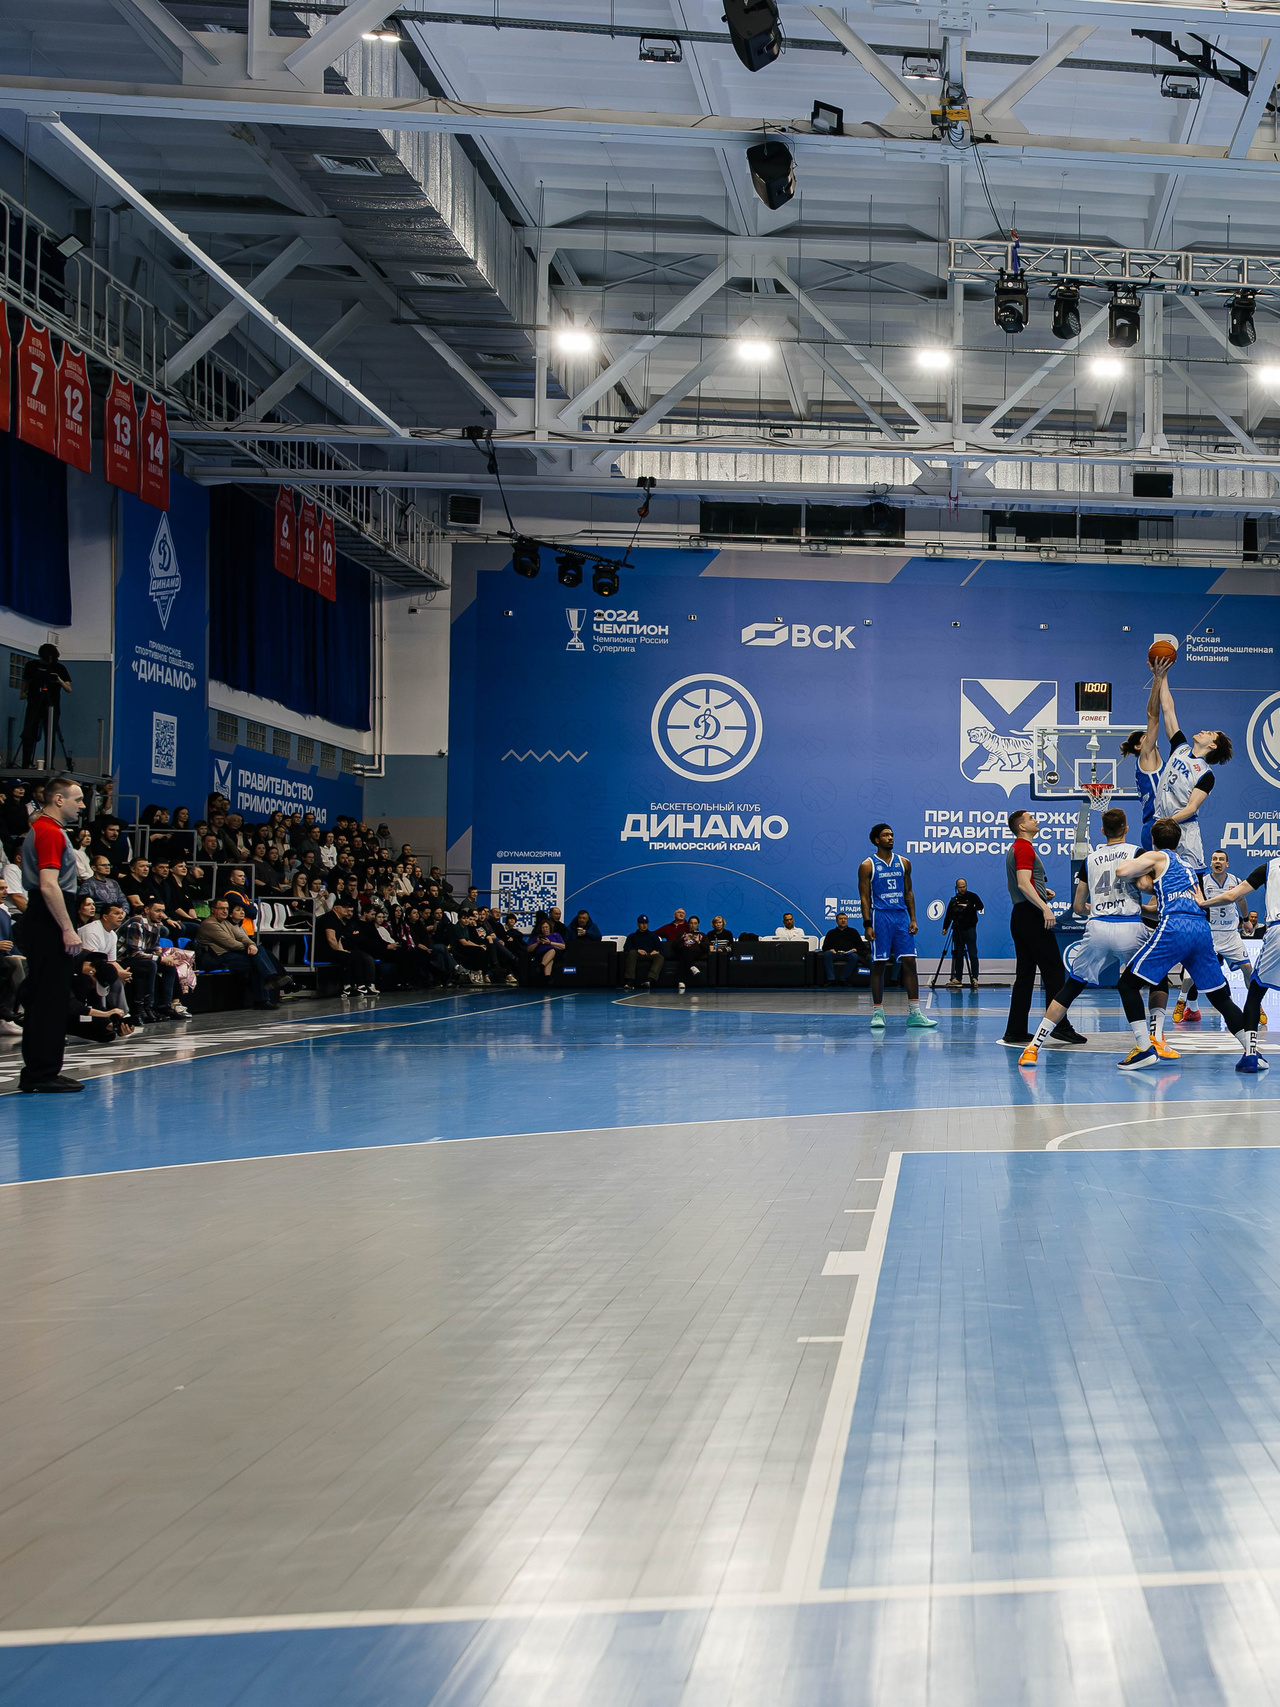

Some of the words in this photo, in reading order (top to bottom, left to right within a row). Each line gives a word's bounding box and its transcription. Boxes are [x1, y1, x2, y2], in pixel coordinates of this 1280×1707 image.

[31, 362, 44, 396] 7
[64, 385, 83, 422] 12
[113, 412, 131, 446] 13
[148, 431, 164, 466] 14
[282, 514, 289, 539] 6
[304, 528, 315, 554] 11
[322, 540, 332, 567] 10
[152, 577, 180, 591] ДИНАМО
[593, 609, 640, 622] 2024
[592, 623, 669, 636] ЧЕМПИОН
[592, 635, 638, 644] Чемпионат
[640, 636, 669, 644] России
[1186, 634, 1220, 644] Русская
[148, 640, 182, 658] ПРИМОРСКОЕ
[592, 644, 636, 654] Суперлига
[1186, 644, 1274, 654] Рыбопромышленная
[134, 645, 168, 663] СПОРТИВНОЕ
[168, 655, 194, 671] ОБЩЕСТВО
[1186, 654, 1229, 662] Компания
[131, 658, 197, 691] «ДИНАМО»
[238, 769, 314, 802] ПРАВИТЕЛЬСТВО
[650, 802, 735, 812] БАСКЕТБОЛЬНЫЙ
[736, 804, 761, 812] КЛУБ
[924, 810, 963, 823] ПРИ
[620, 814, 789, 842] ДИНАМО
[649, 841, 728, 850] ПРИМОРСКИЙ
[730, 842, 761, 851] КРАЙ
[496, 850, 561, 858] @DYNAMO25PRIM
[887, 879, 896, 890] 53
[1220, 908, 1226, 918] 5
